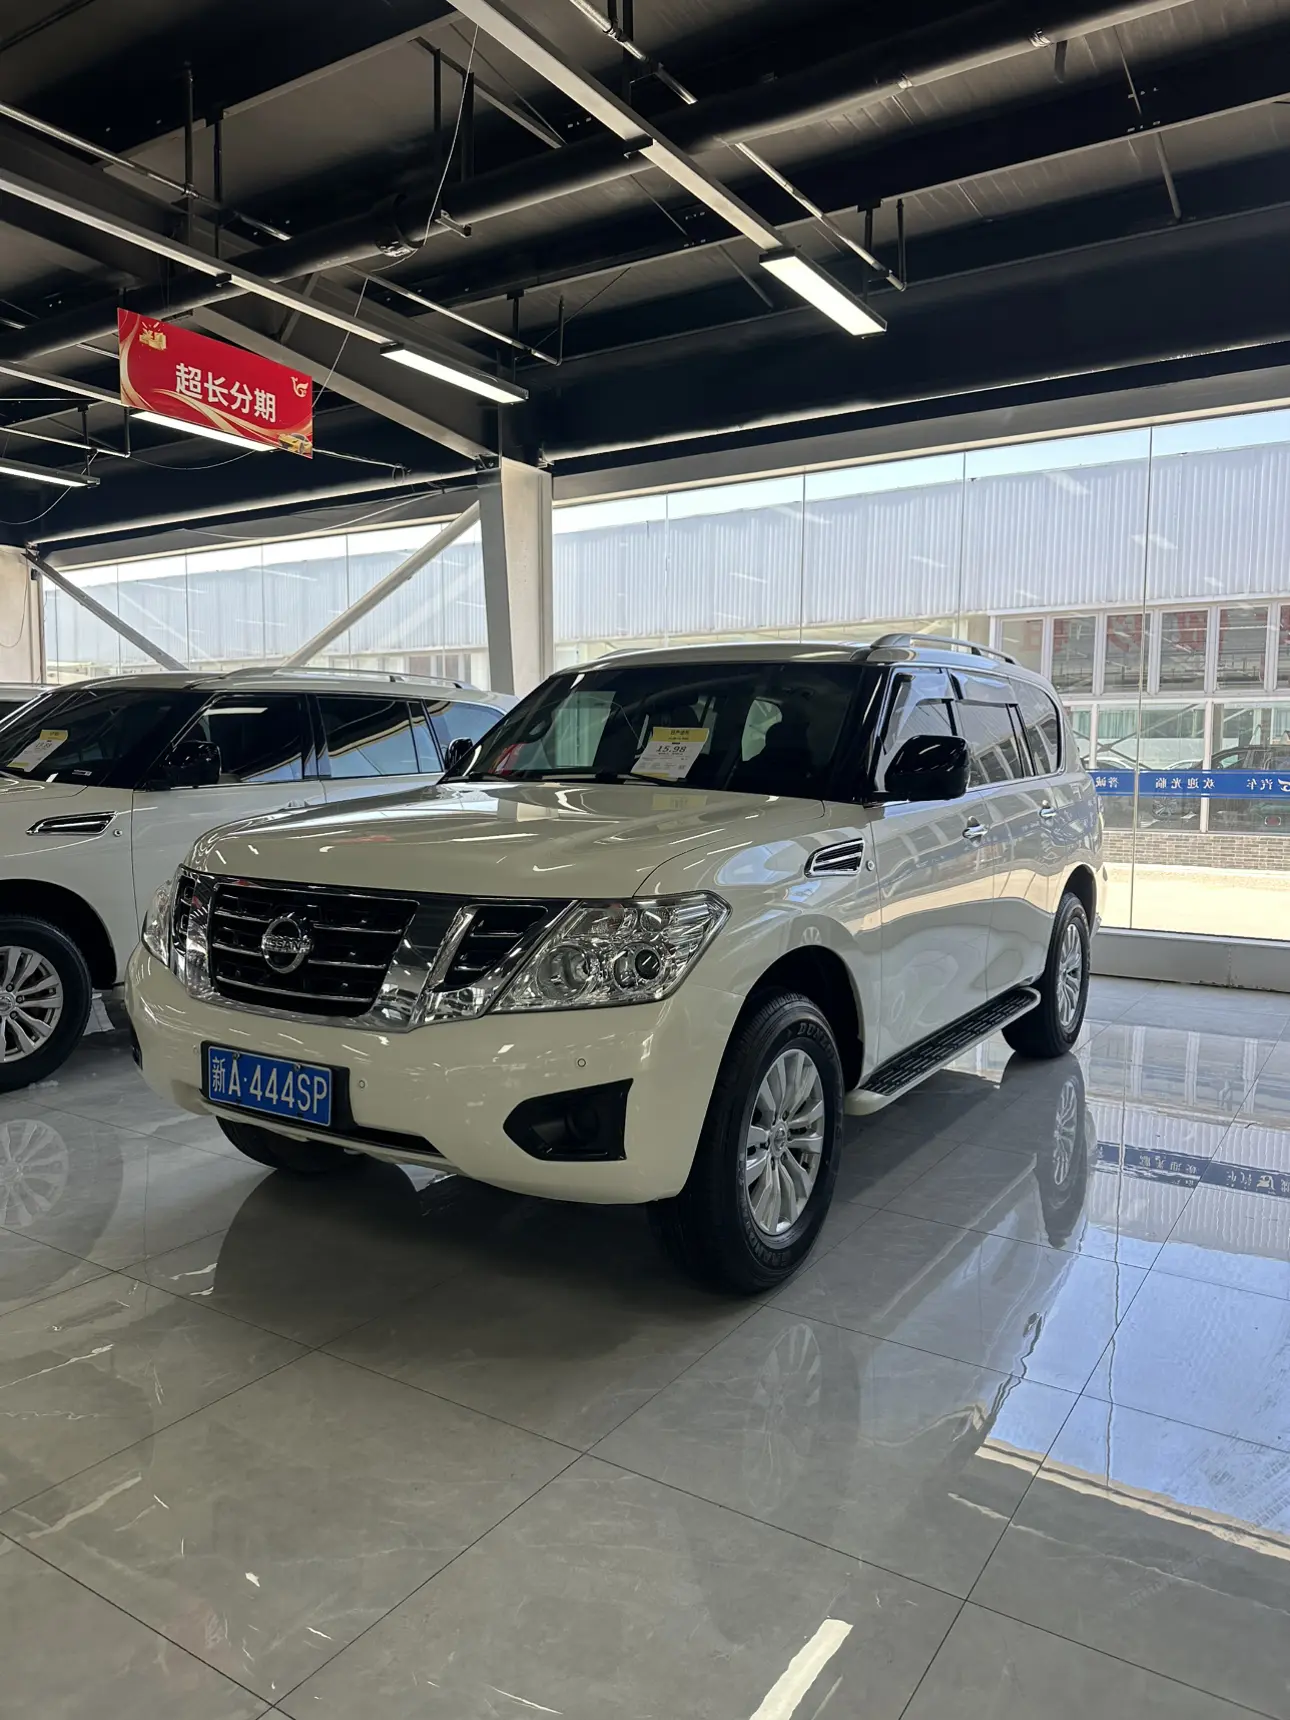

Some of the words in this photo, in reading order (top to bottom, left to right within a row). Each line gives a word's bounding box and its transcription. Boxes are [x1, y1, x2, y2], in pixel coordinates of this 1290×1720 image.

[175, 362, 276, 423] 超长分期
[656, 745, 687, 753] 15.98
[211, 1056, 328, 1114] 新A·444SP
